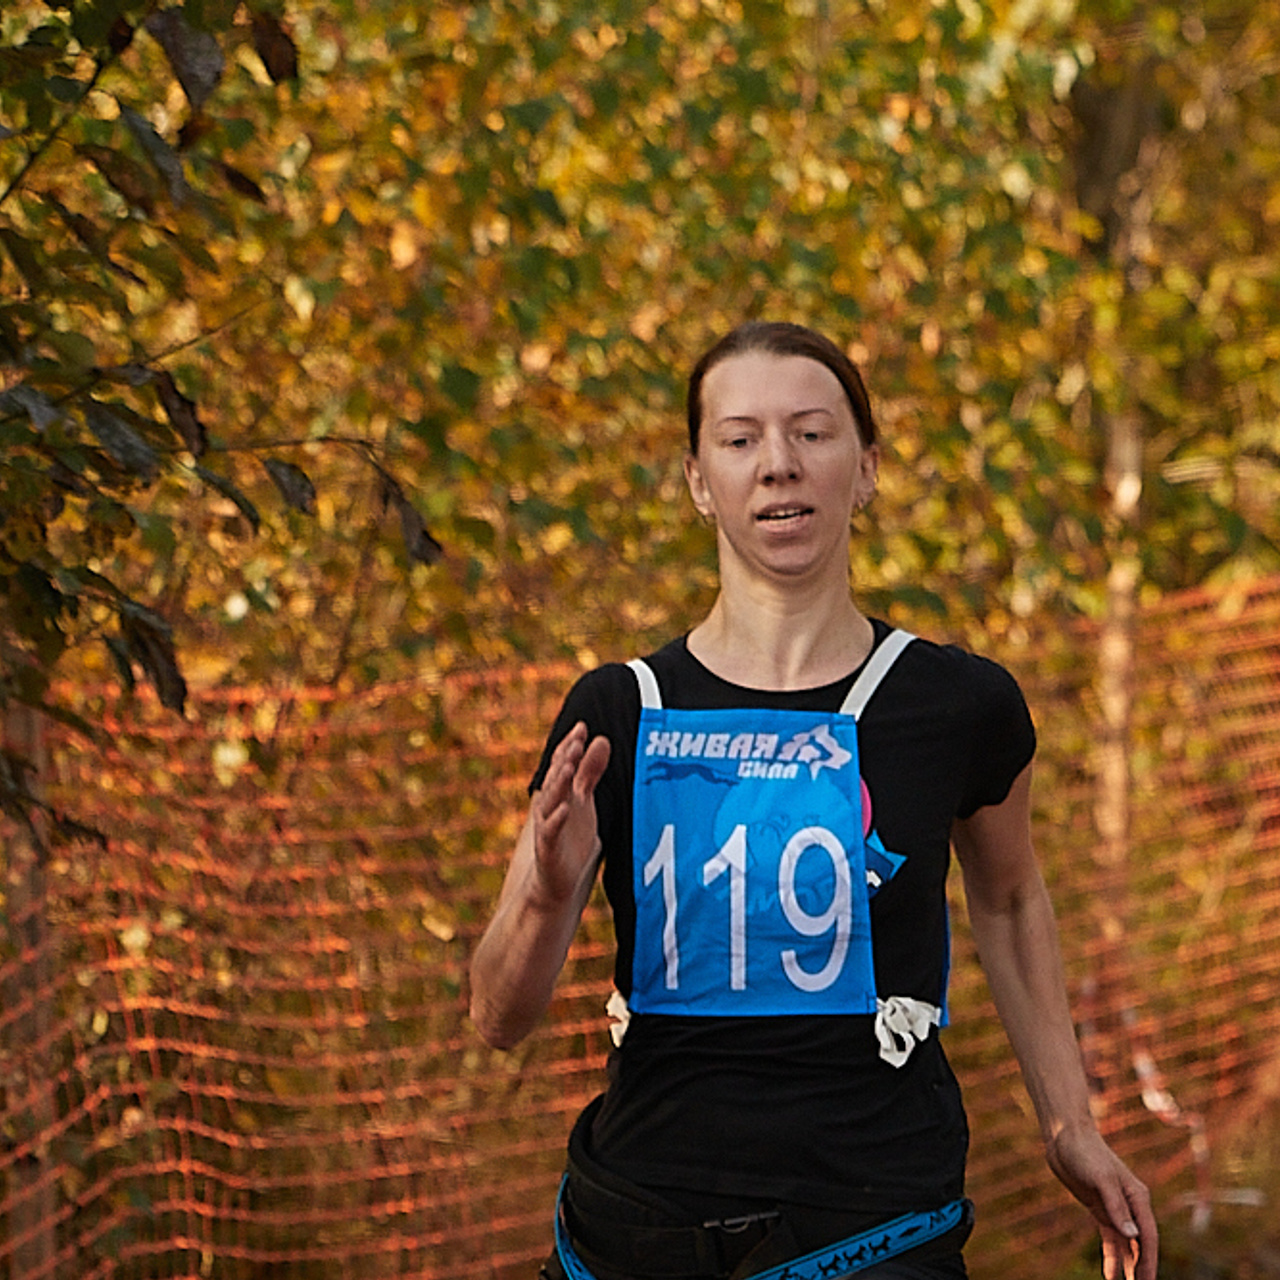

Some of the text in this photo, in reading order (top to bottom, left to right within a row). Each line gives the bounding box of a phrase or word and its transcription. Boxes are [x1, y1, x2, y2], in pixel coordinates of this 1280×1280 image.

[645, 731, 780, 758] ЖИВАЯ
[737, 760, 800, 780] СИЛА
[643, 823, 852, 992] 119
